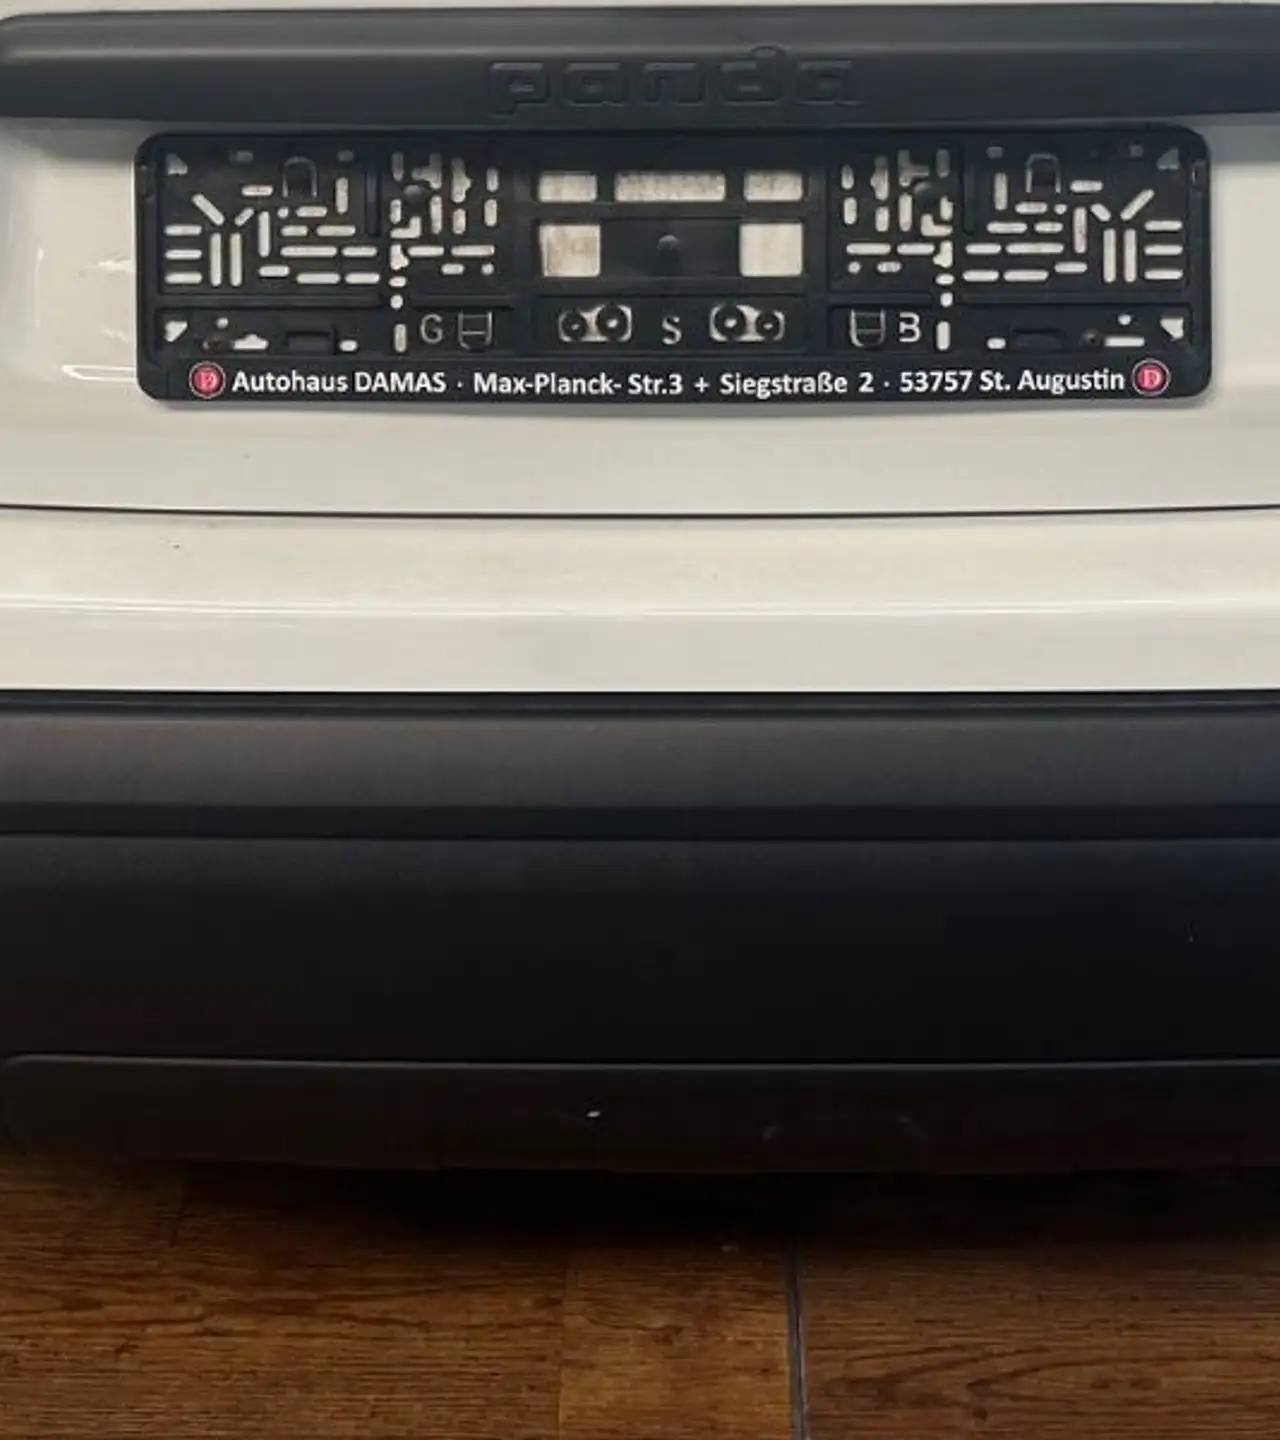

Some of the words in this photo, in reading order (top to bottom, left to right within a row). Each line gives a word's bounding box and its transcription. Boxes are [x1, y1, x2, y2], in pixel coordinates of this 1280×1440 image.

[231, 369, 348, 392] Autohaus
[354, 371, 446, 392] DAMAS
[474, 372, 621, 394] Max-Planck-
[628, 373, 682, 394] Str.3
[720, 372, 847, 399] Siegstraße
[858, 371, 873, 392] 2
[900, 370, 972, 392] 53757
[979, 369, 1010, 391] St.
[1017, 368, 1124, 394] Augustin
